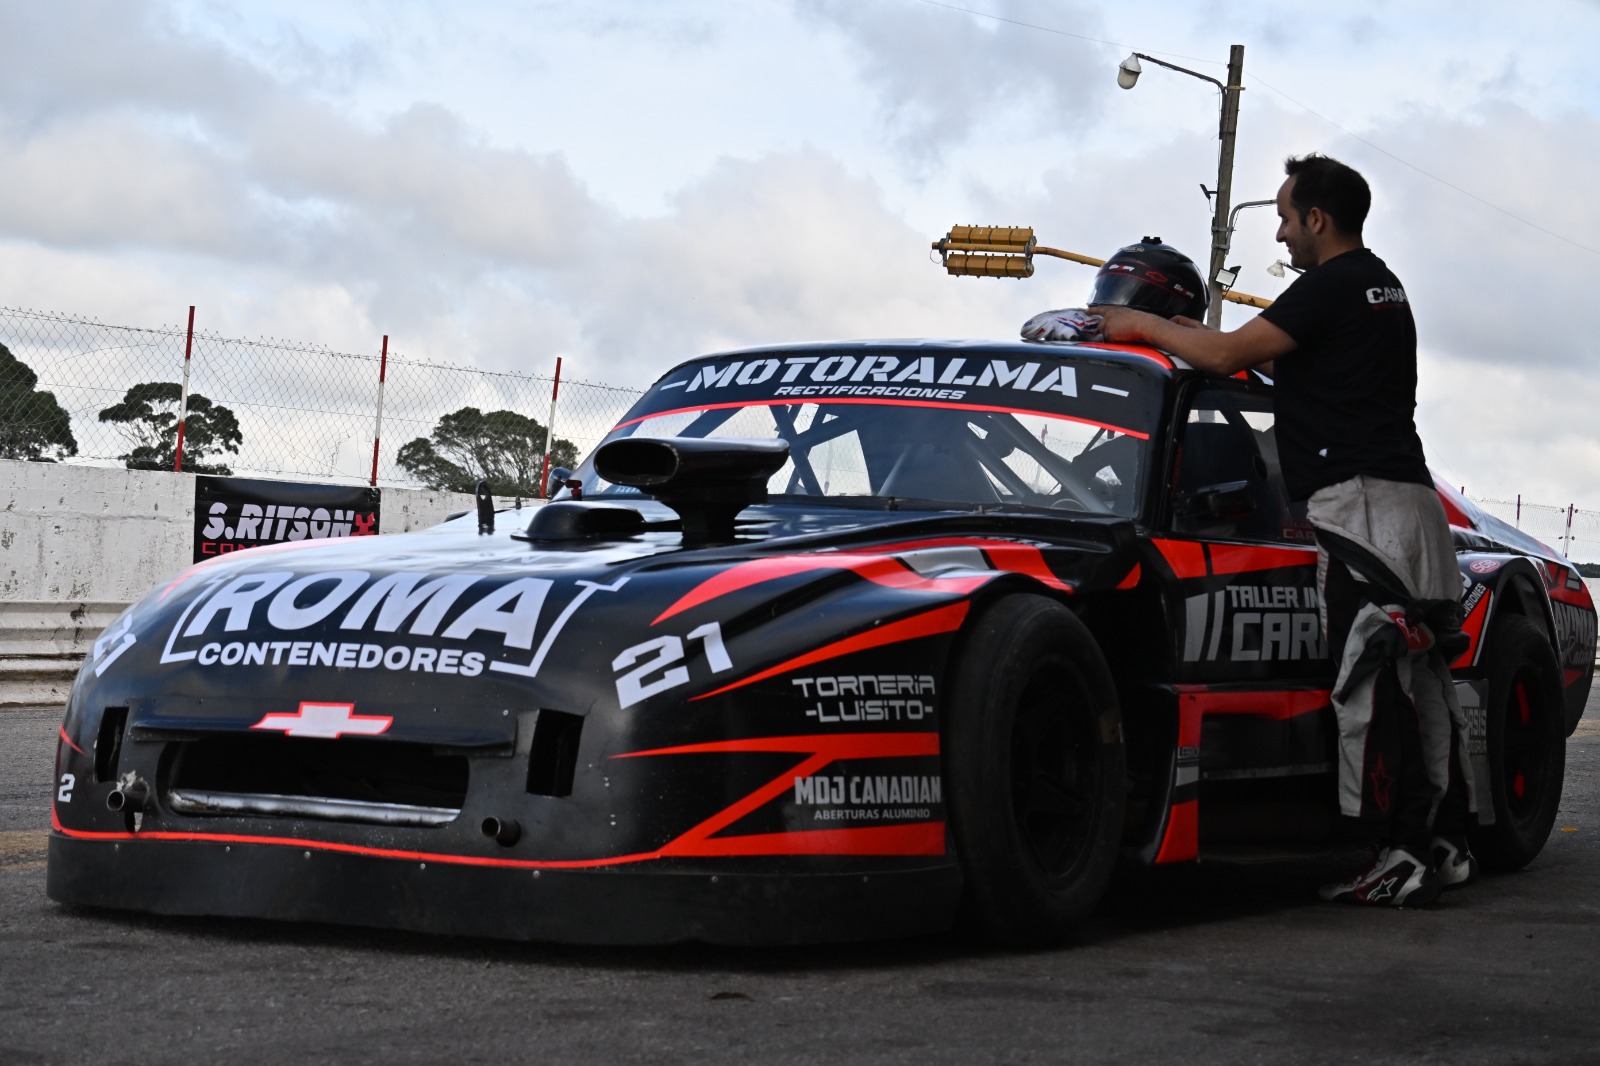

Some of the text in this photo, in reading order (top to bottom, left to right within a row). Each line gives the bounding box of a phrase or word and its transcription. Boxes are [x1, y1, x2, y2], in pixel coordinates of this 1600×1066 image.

[773, 385, 967, 401] RECTIFICACIONES
[183, 570, 554, 649] ROMA
[1226, 585, 1299, 608] TALLER
[1230, 612, 1329, 661] CAR
[198, 641, 486, 677] CONTENEDORES
[611, 621, 733, 710] 21
[849, 775, 942, 805] CANADIAN
[814, 808, 931, 820] ABERTURAS ALUMINIO
